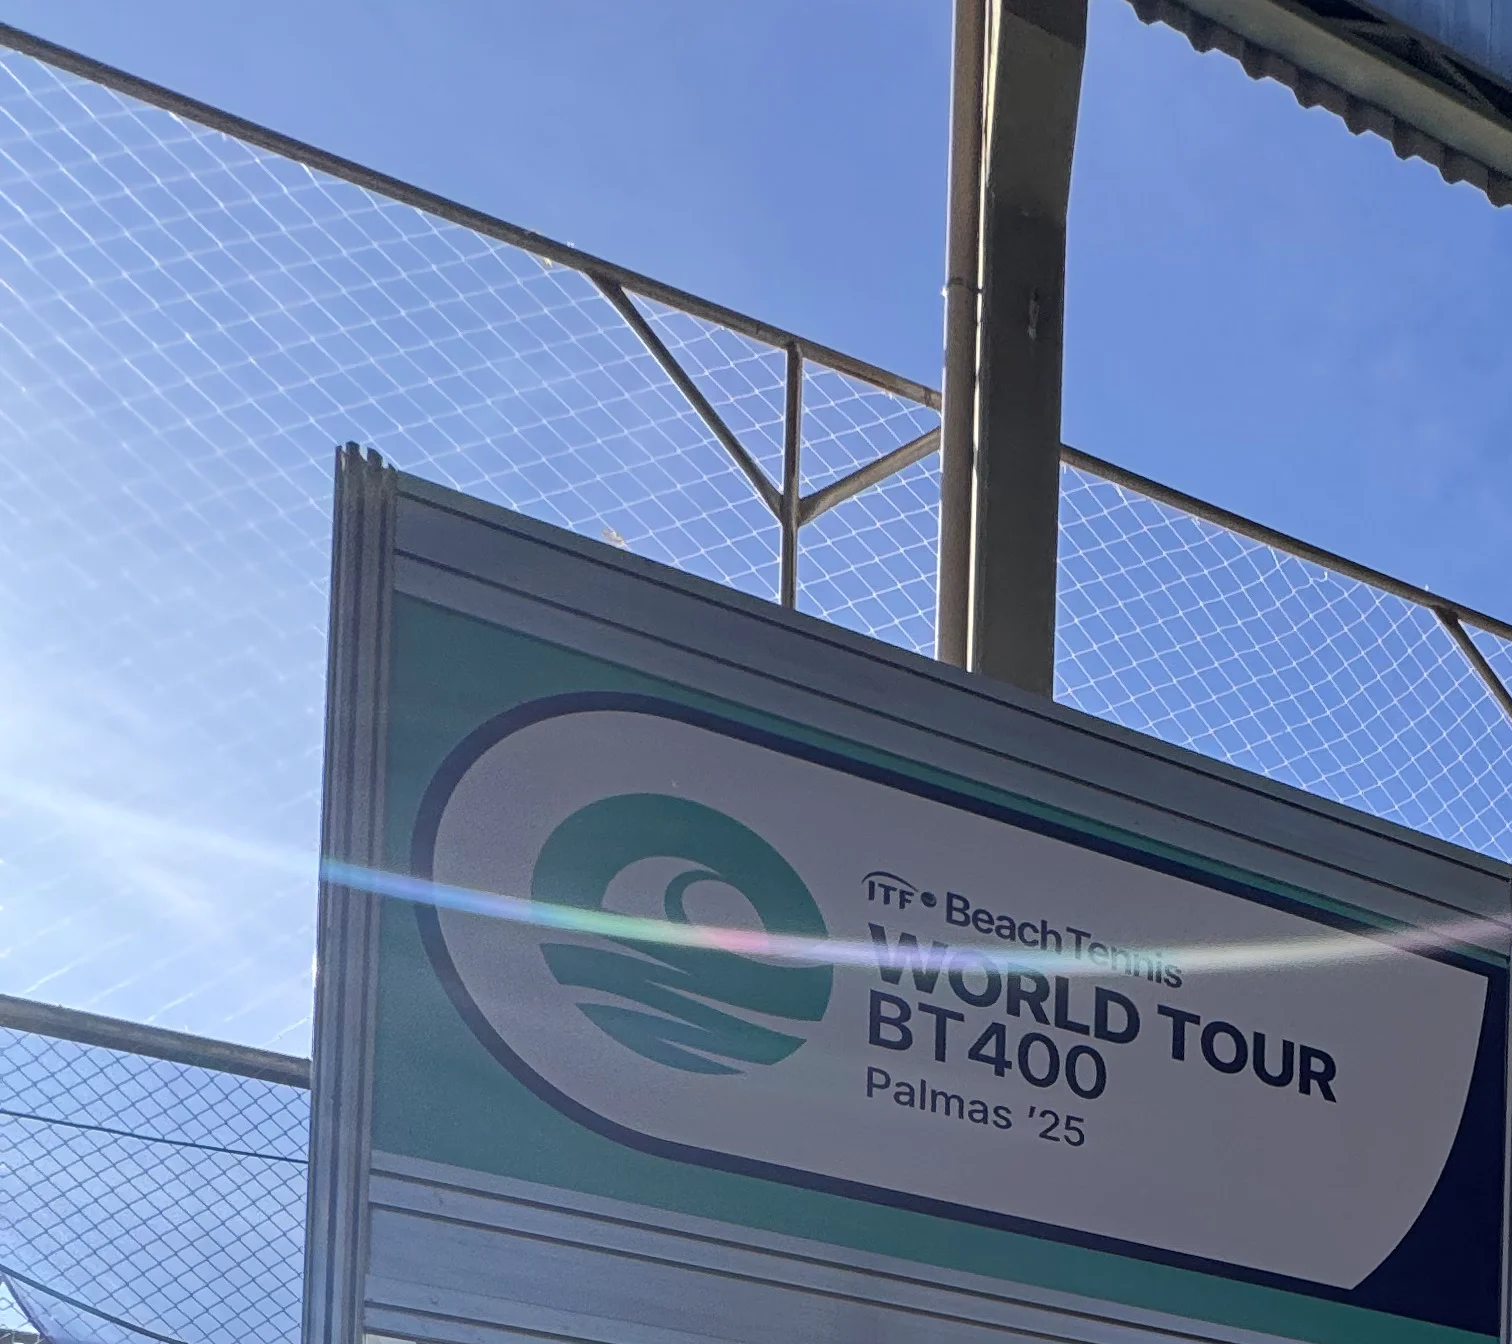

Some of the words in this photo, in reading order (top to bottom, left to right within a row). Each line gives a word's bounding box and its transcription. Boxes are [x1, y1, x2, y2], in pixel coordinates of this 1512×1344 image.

[867, 881, 915, 909] ITF
[868, 922, 1141, 1045] WORLD
[1157, 1003, 1338, 1104] TOUR
[868, 989, 1107, 1100] BT400
[866, 1066, 1013, 1131] Palmas
